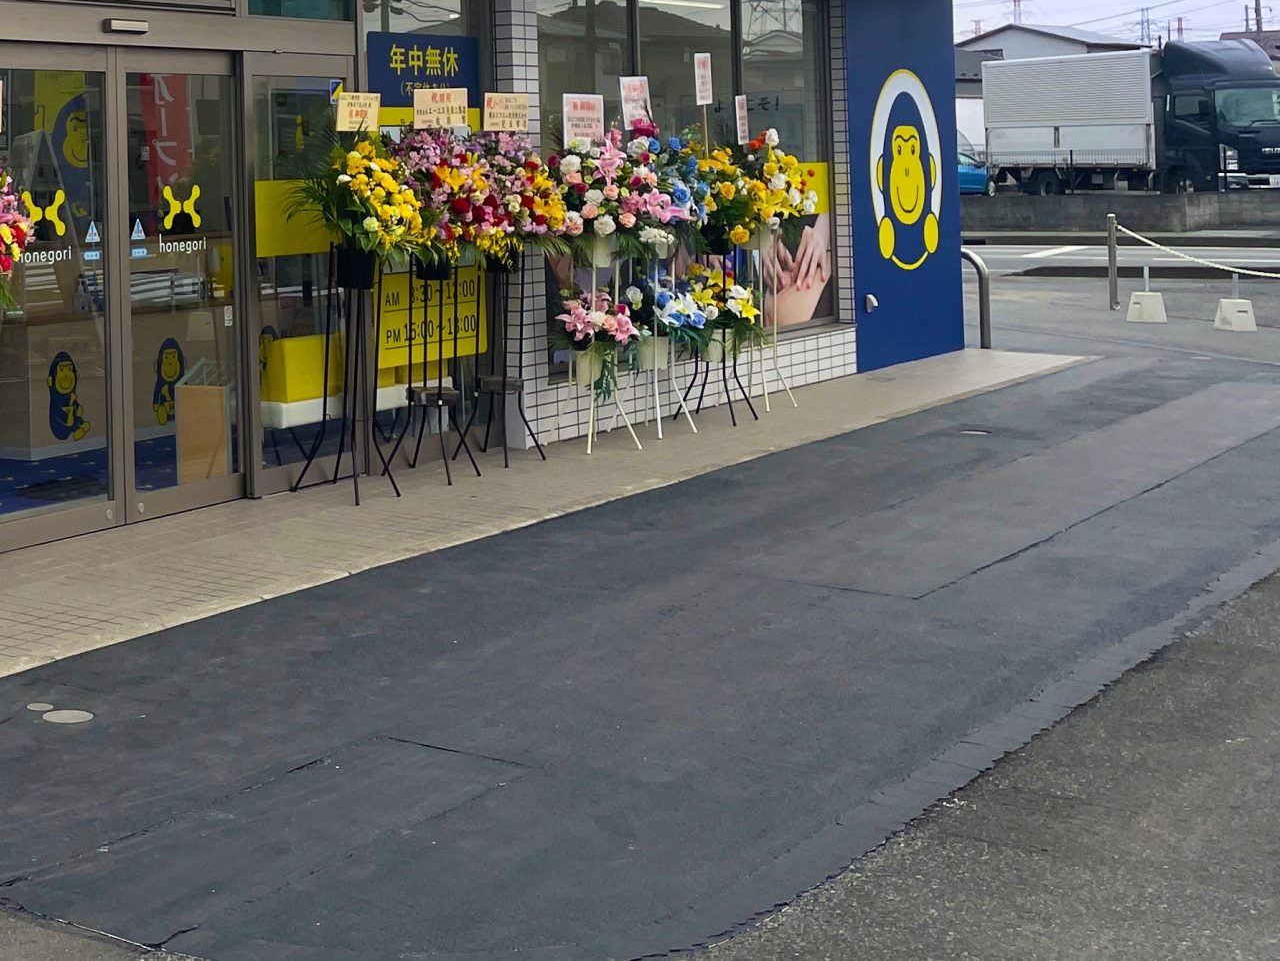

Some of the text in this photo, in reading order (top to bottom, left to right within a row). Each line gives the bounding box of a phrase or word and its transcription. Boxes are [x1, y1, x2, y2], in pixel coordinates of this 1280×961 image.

[389, 43, 459, 77] 年中無休
[159, 233, 207, 255] honegori
[385, 291, 400, 307] AM
[386, 327, 401, 344] PM
